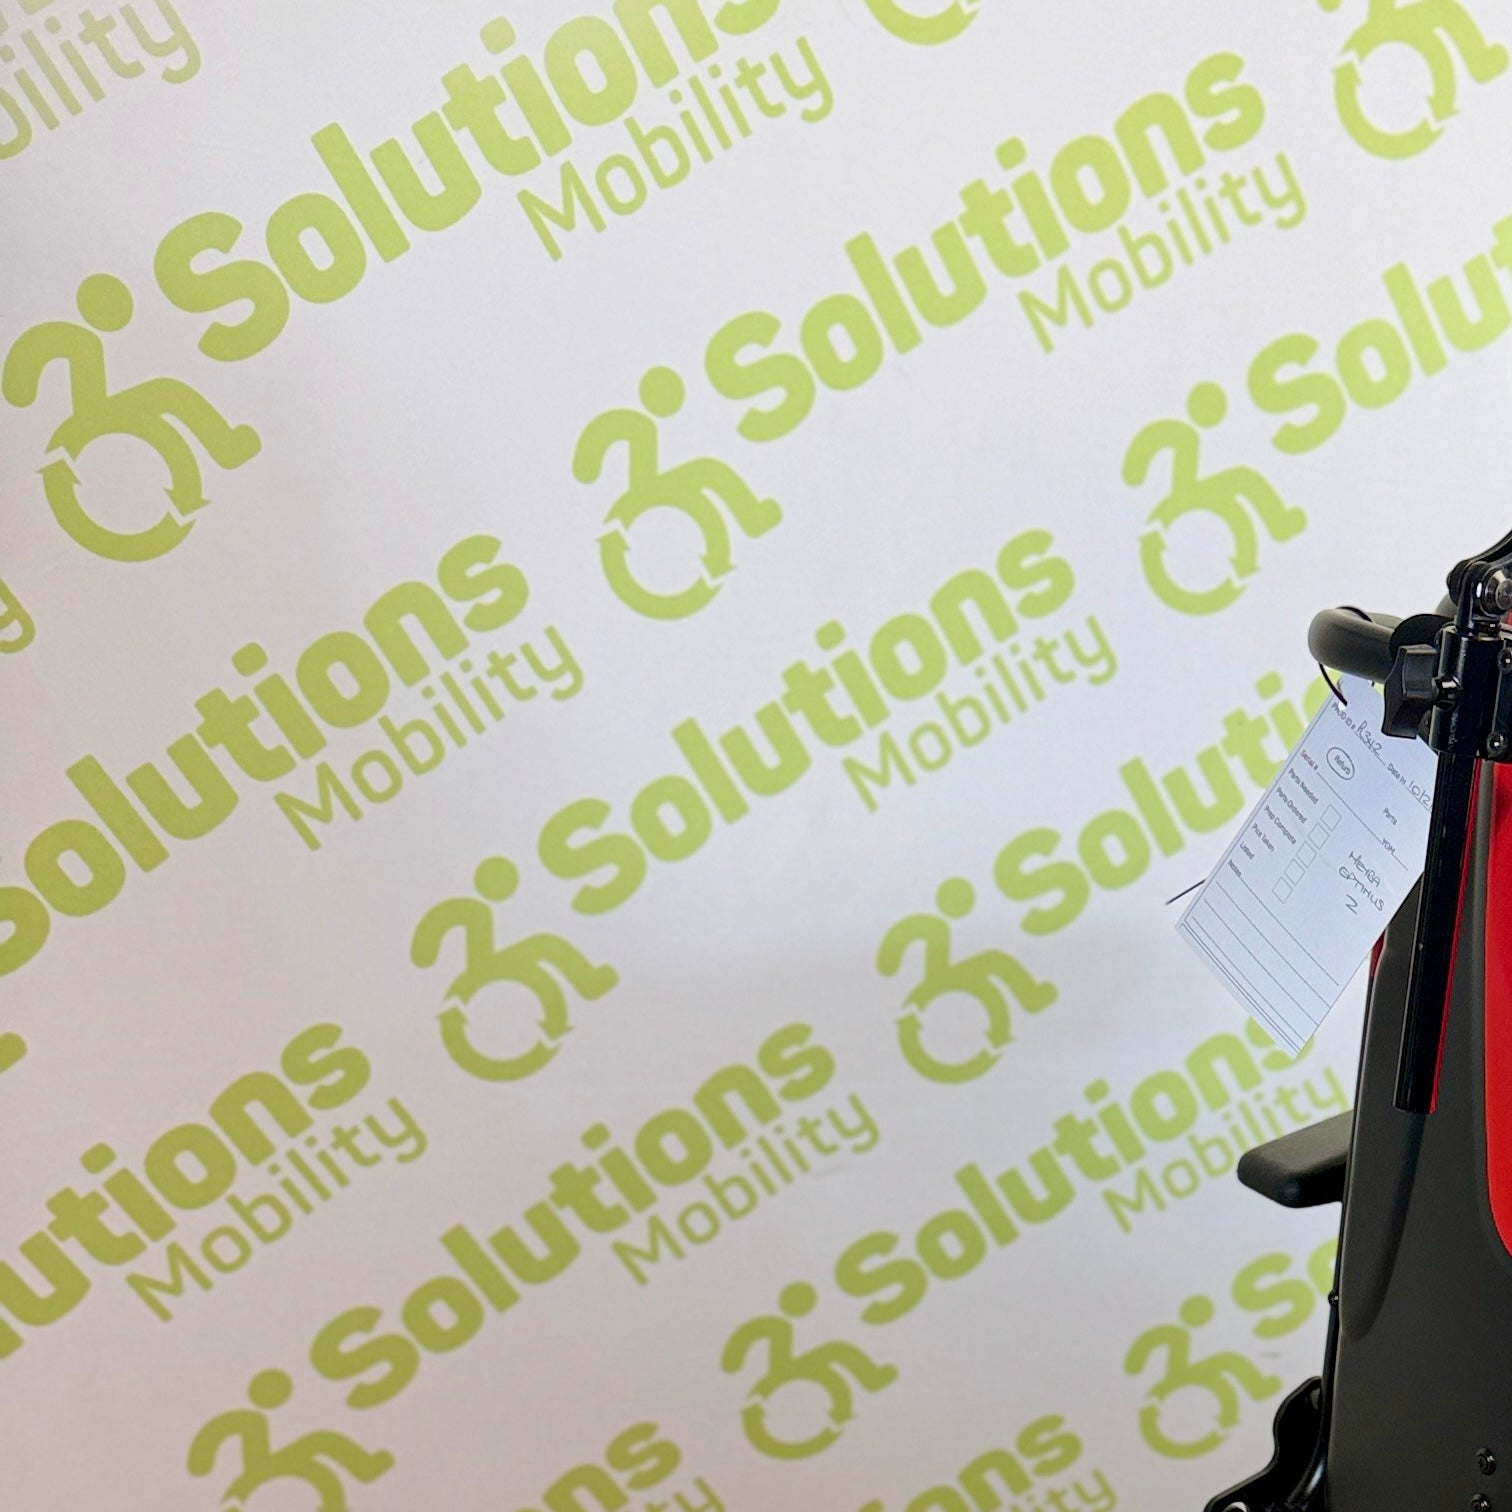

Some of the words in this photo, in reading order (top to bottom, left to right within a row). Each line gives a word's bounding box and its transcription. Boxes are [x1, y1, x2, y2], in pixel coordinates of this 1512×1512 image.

[516, 35, 835, 262] Mobility
[704, 52, 1266, 443] Solutions
[1017, 152, 1307, 354] Mobility
[273, 626, 584, 851] Mobility
[537, 528, 1076, 916] Solutions
[842, 615, 1118, 812] Mobility
[1010, 668, 1341, 936] Soluti
[0, 1022, 372, 1360] utions
[125, 1097, 428, 1323] Mobility
[310, 1022, 836, 1410] Solutions
[610, 1095, 881, 1287] Mobility
[1102, 1067, 1351, 1234] Mobility
